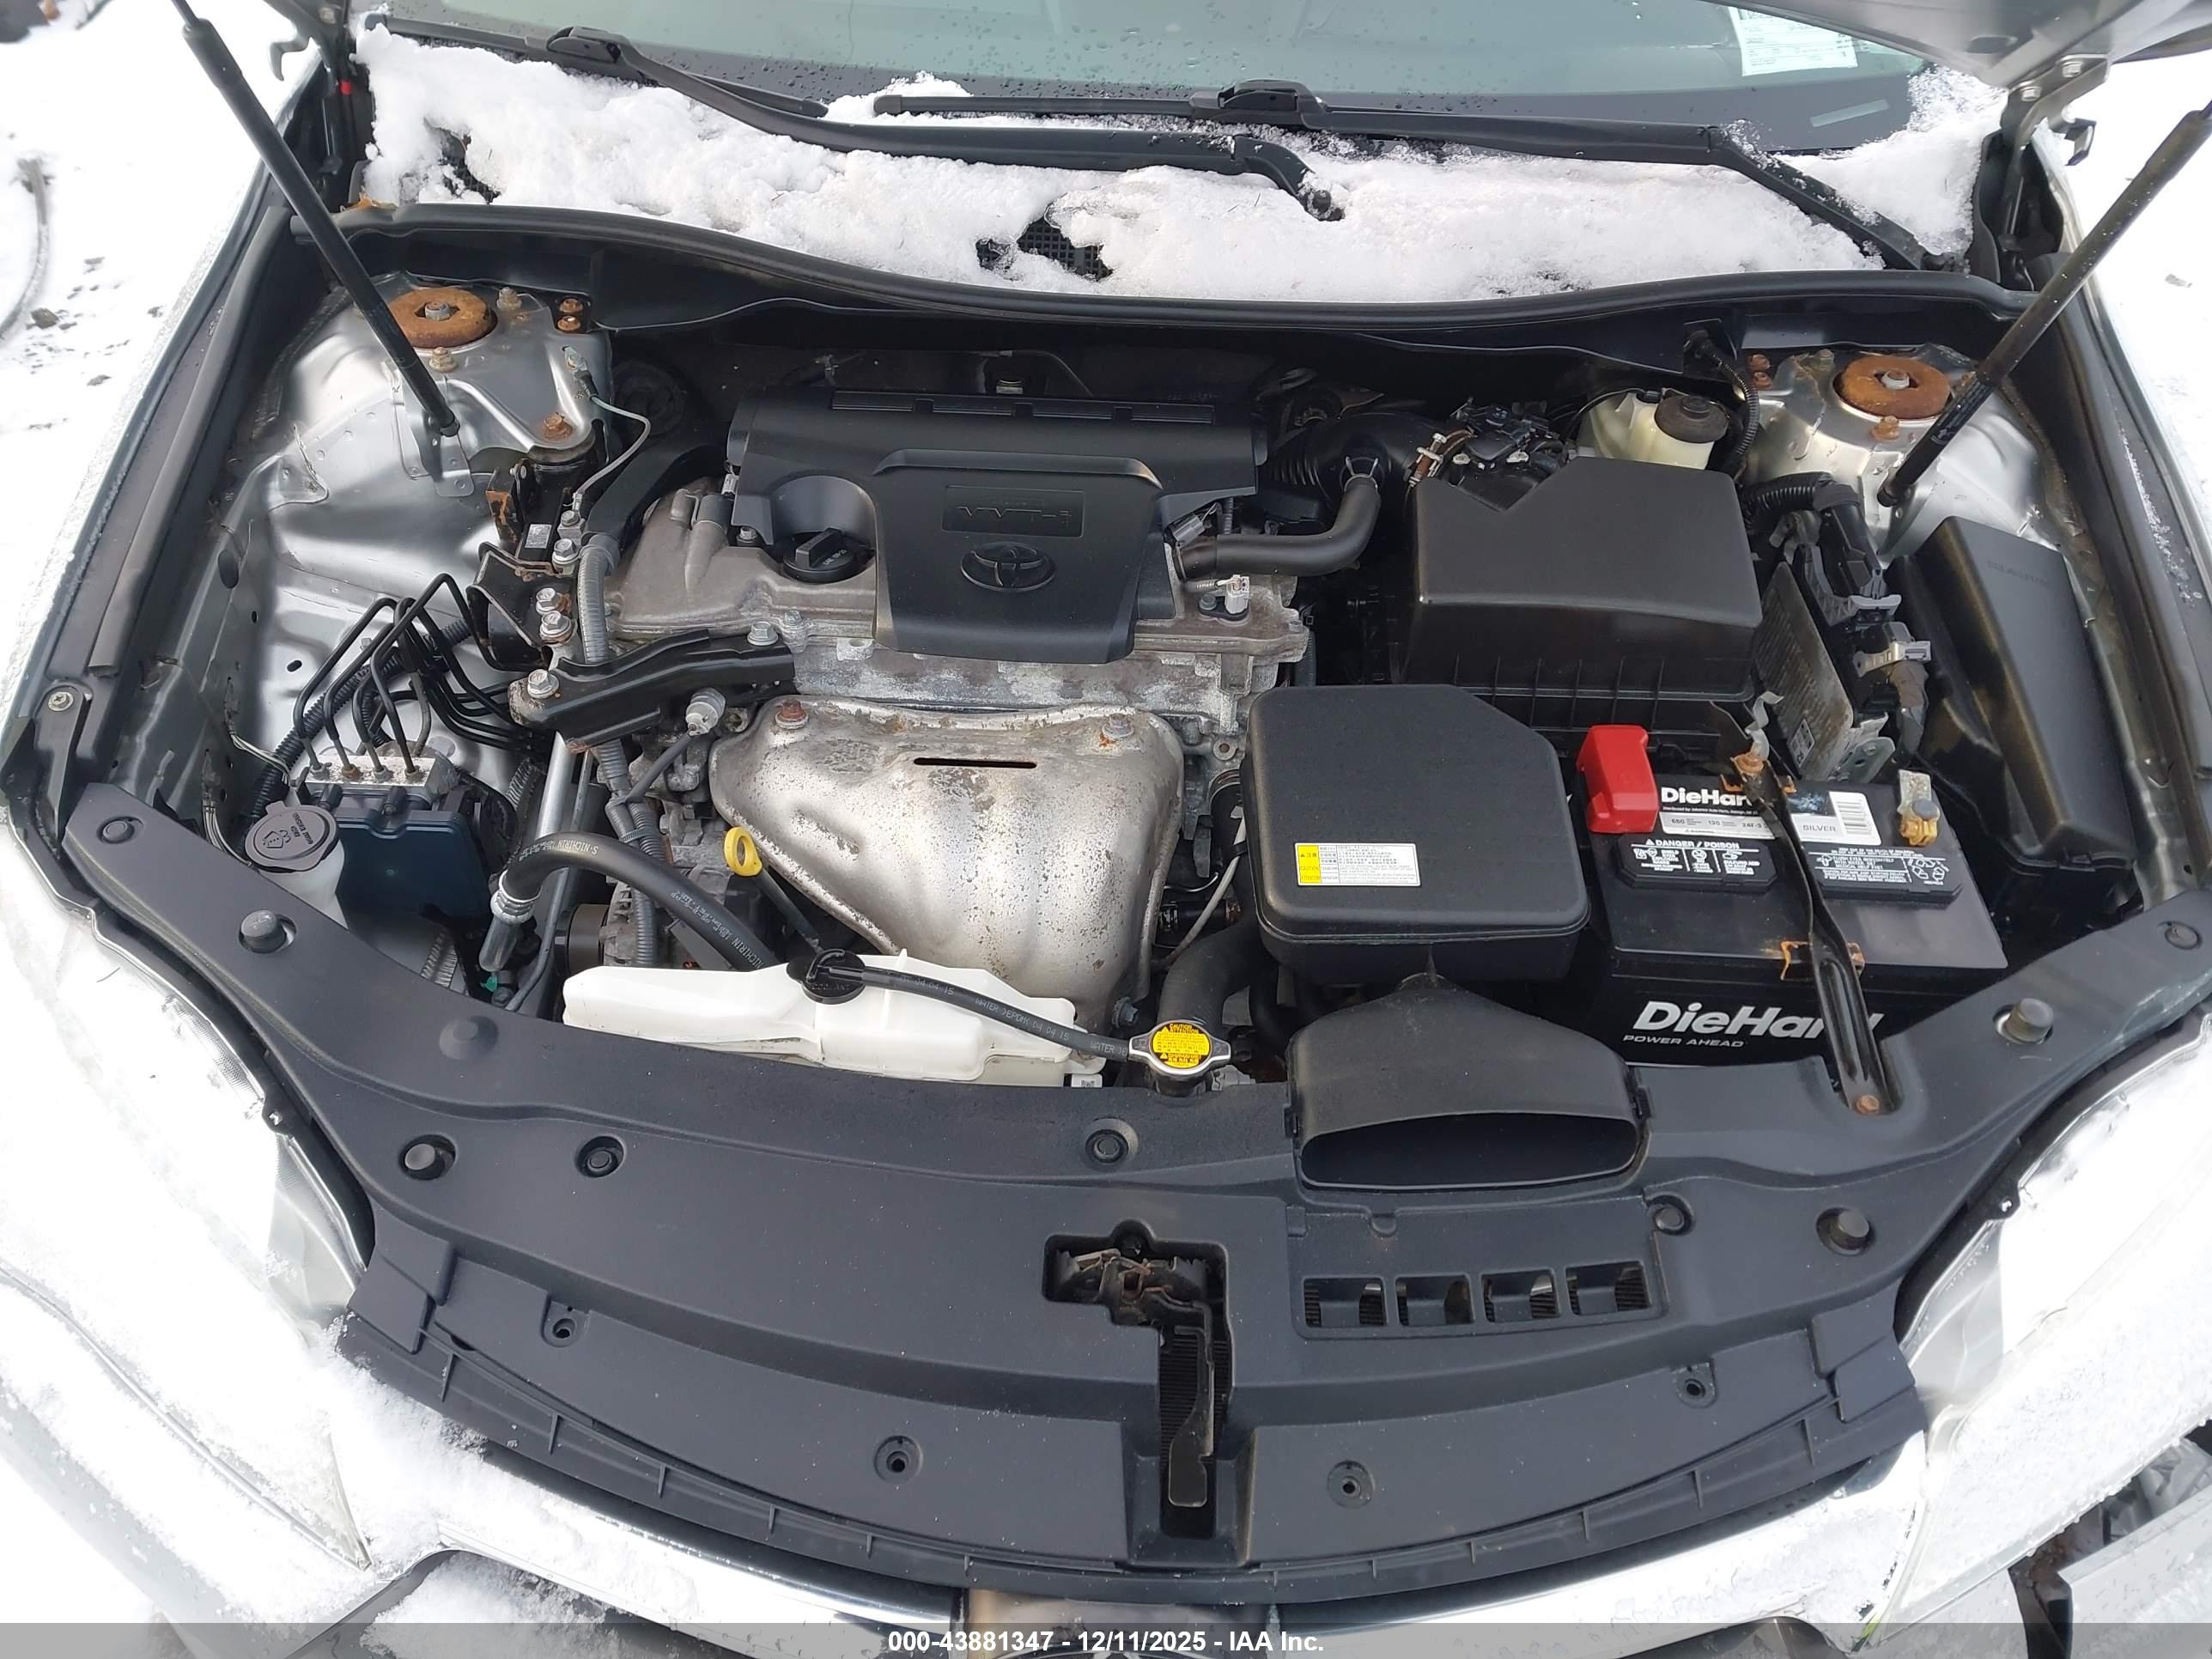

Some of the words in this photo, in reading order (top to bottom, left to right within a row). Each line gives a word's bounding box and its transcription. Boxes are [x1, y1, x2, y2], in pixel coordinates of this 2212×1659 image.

[1661, 787, 1753, 806] DieHar
[1656, 839, 1695, 848] DANGER
[1622, 1035, 1681, 1045] POWER
[1686, 1039, 1745, 1048] AHEAD
